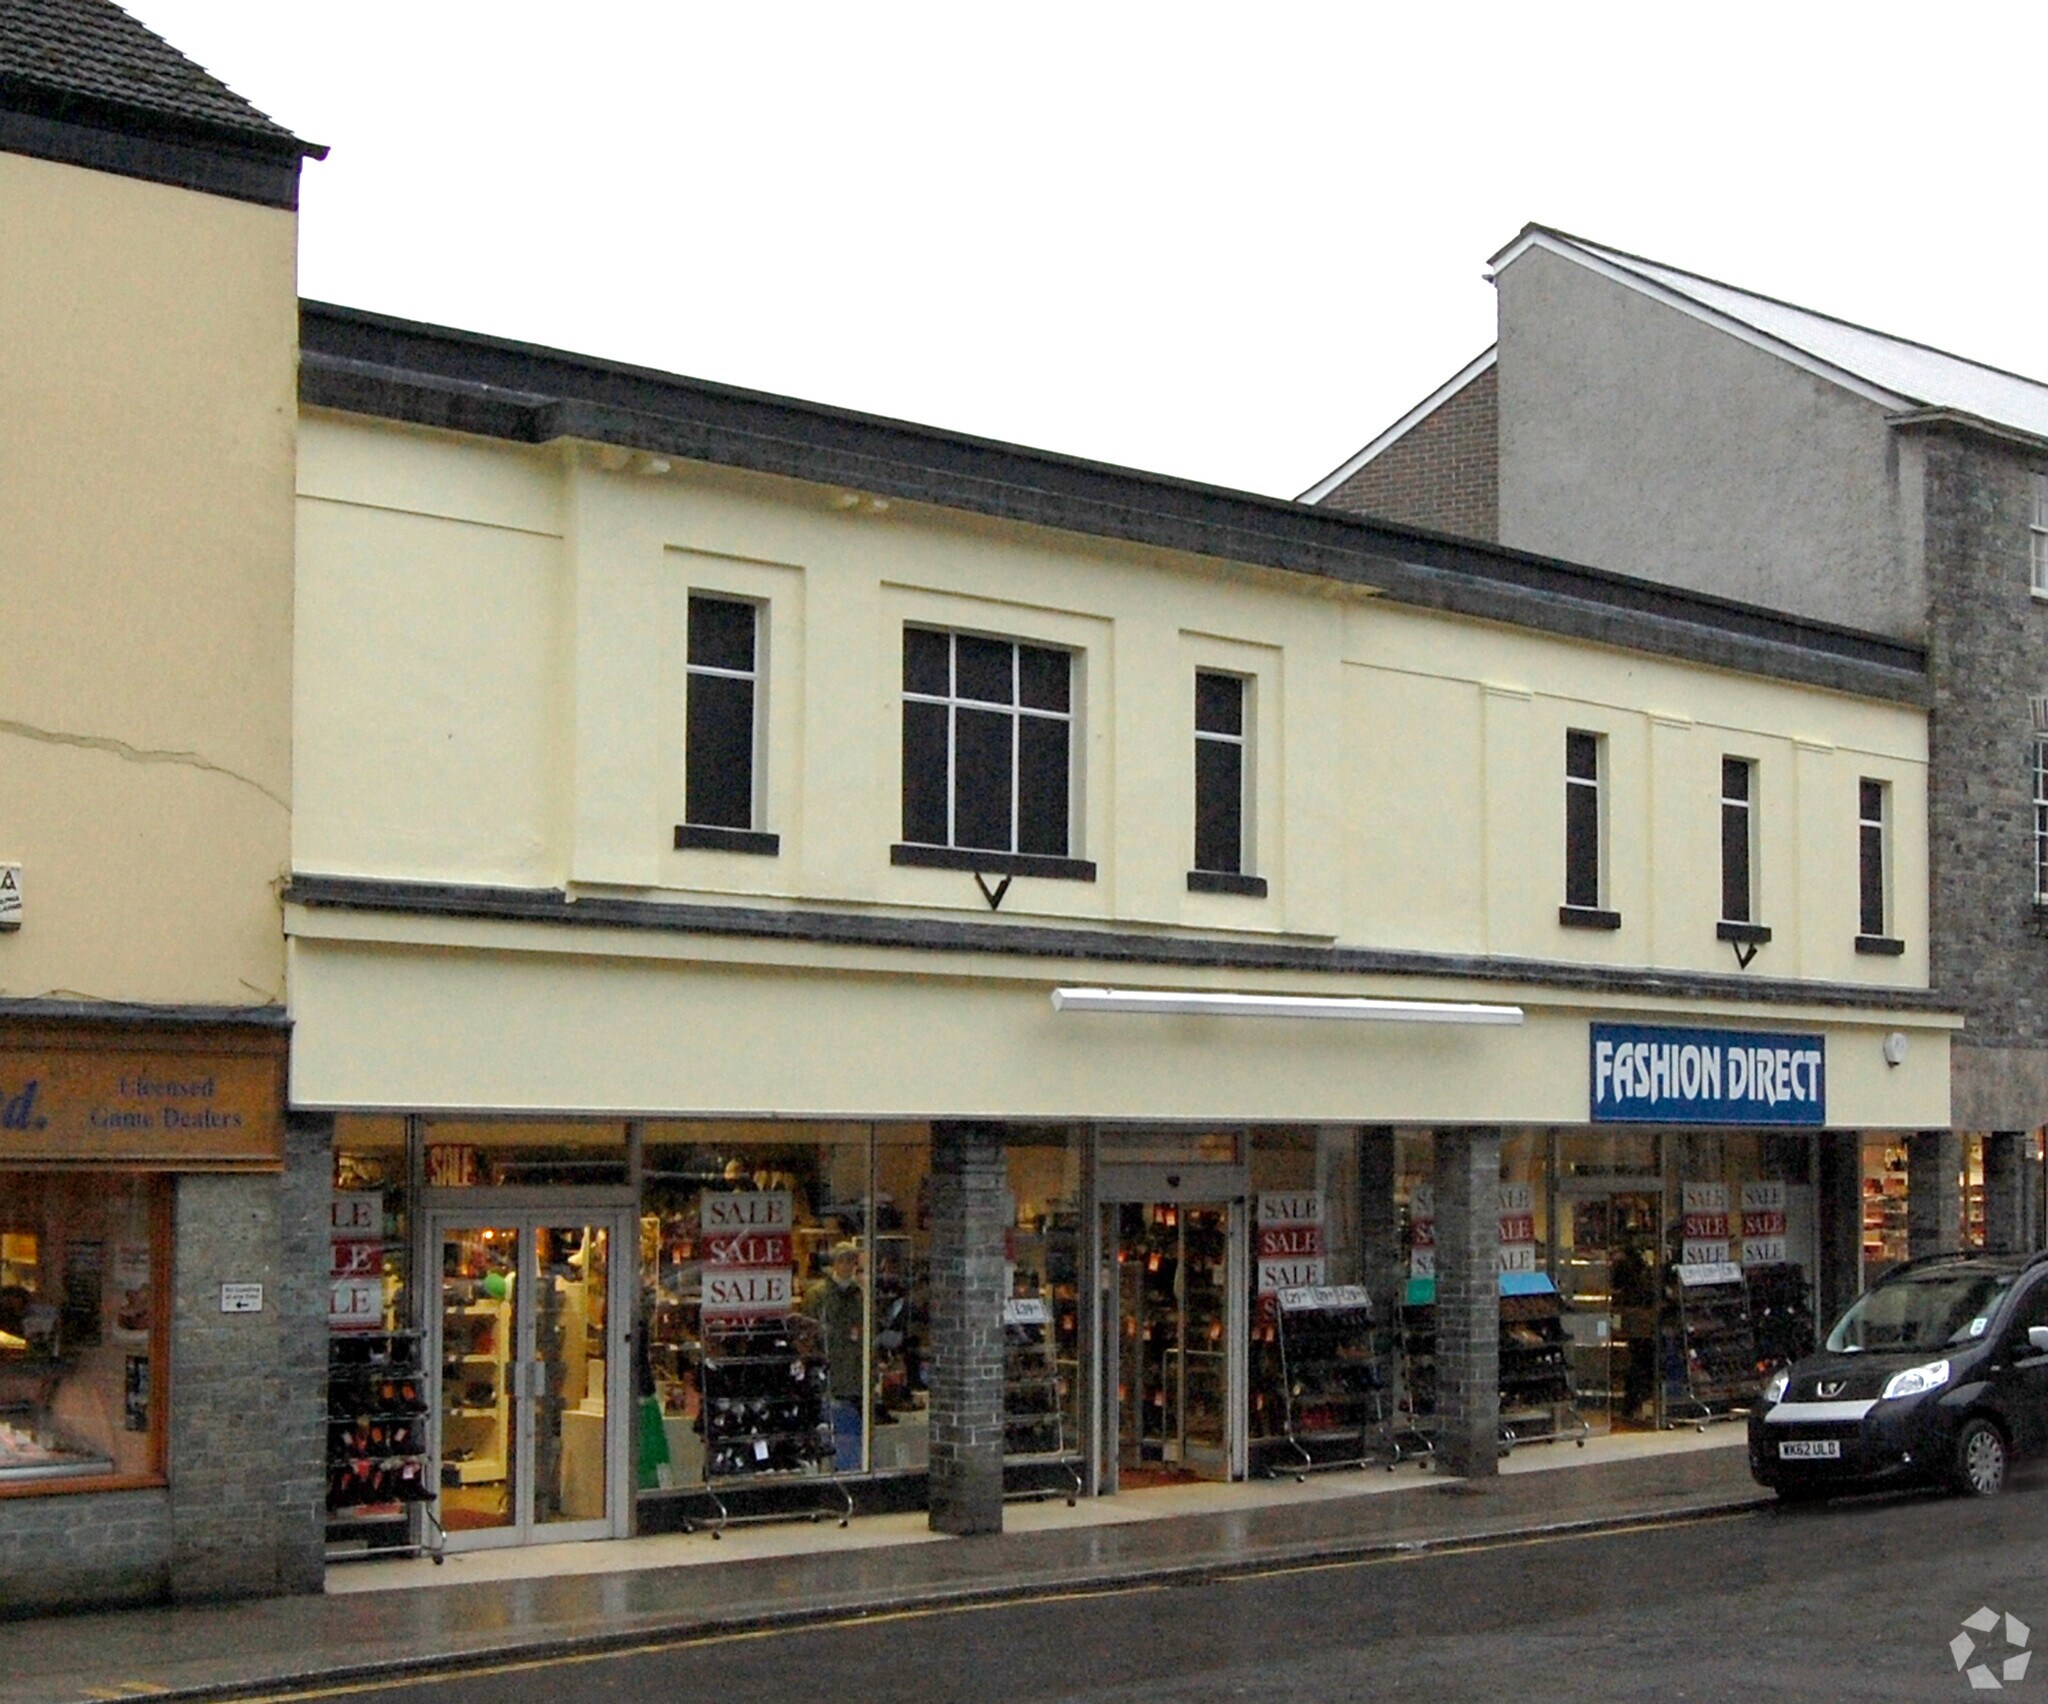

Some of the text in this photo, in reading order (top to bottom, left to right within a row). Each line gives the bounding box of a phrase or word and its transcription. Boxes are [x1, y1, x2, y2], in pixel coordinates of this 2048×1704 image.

[1596, 1041, 1822, 1107] FASHION DIRECT
[118, 1076, 215, 1098] Licensed
[91, 1107, 243, 1129] Game Dealers
[332, 1202, 372, 1227] LE
[711, 1201, 783, 1224] SALE
[1265, 1200, 1317, 1219] SALE
[1500, 1220, 1531, 1240] ALE
[1687, 1217, 1725, 1235] SALE
[1745, 1215, 1782, 1234] SALE
[710, 1239, 784, 1264] SALE
[1264, 1231, 1319, 1253] SALE
[1500, 1250, 1530, 1271] ALE
[1687, 1244, 1724, 1264] SALE
[1265, 1264, 1317, 1286] SALE
[329, 1288, 372, 1314] LE
[711, 1278, 784, 1303] SALE
